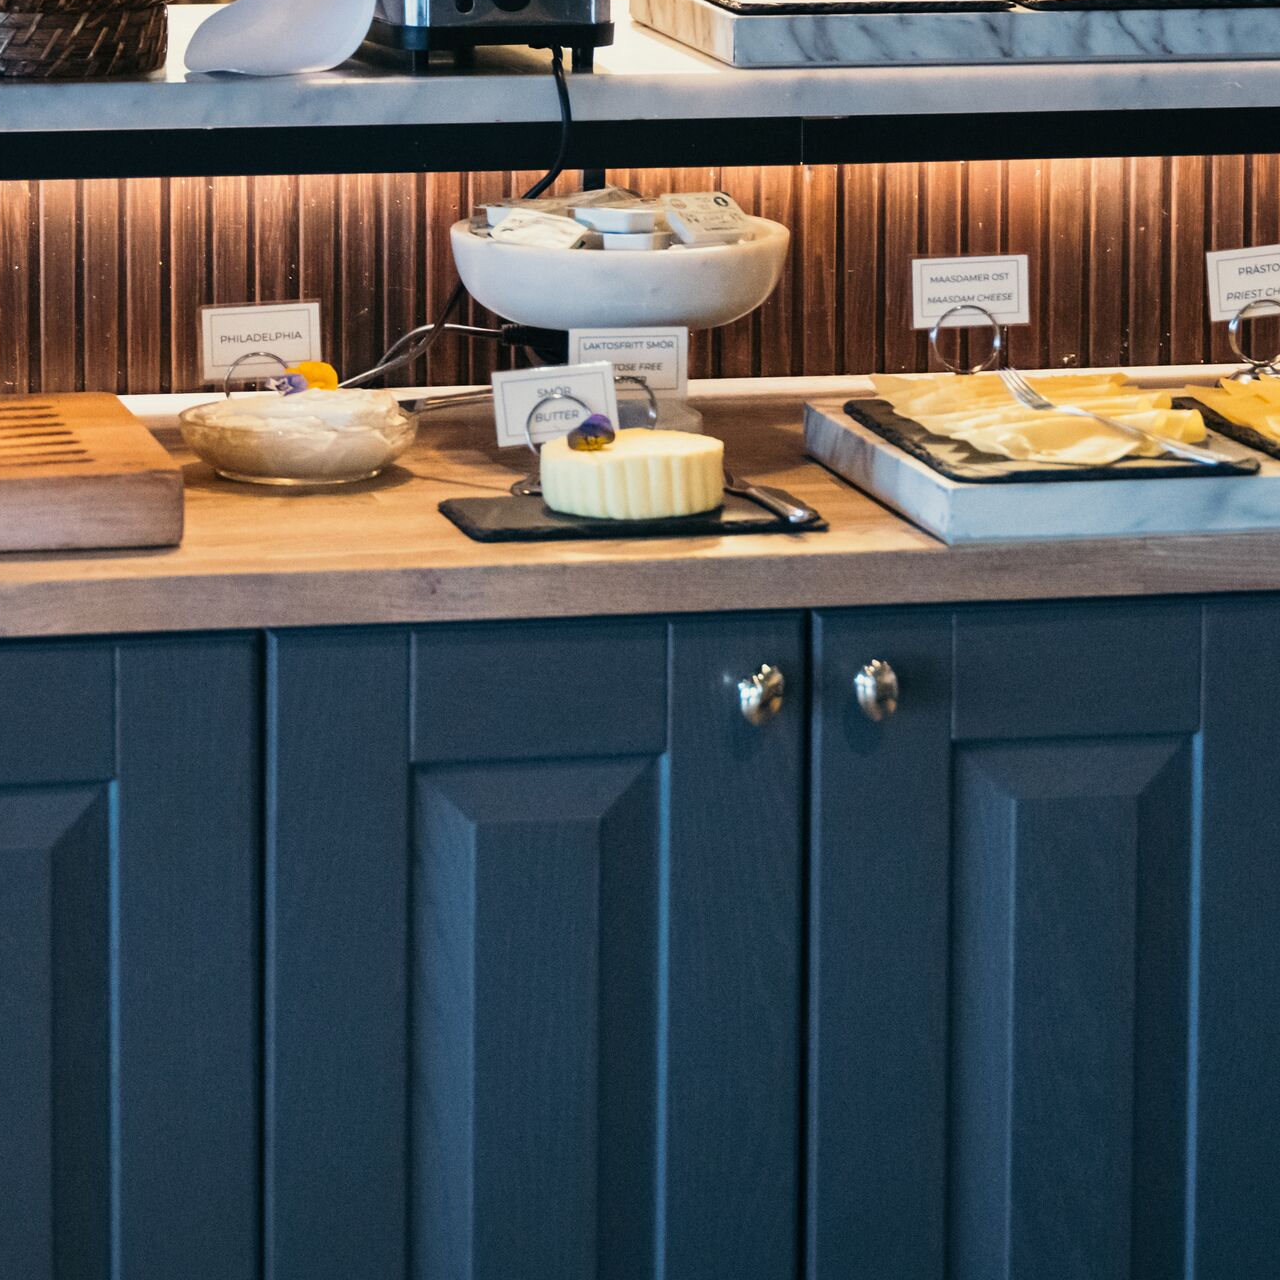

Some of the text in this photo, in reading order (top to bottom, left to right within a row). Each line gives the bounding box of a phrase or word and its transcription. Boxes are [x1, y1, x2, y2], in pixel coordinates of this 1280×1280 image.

[930, 272, 1010, 284] MAASDAMER OST
[928, 292, 1014, 304] MAASDAM CHEESE
[1226, 288, 1264, 301] PRIEST
[220, 331, 303, 344] PHILADELPHIA
[584, 341, 645, 351] LAKTOSFRITT
[638, 362, 663, 371] FREE
[535, 410, 580, 423] BUTTER
